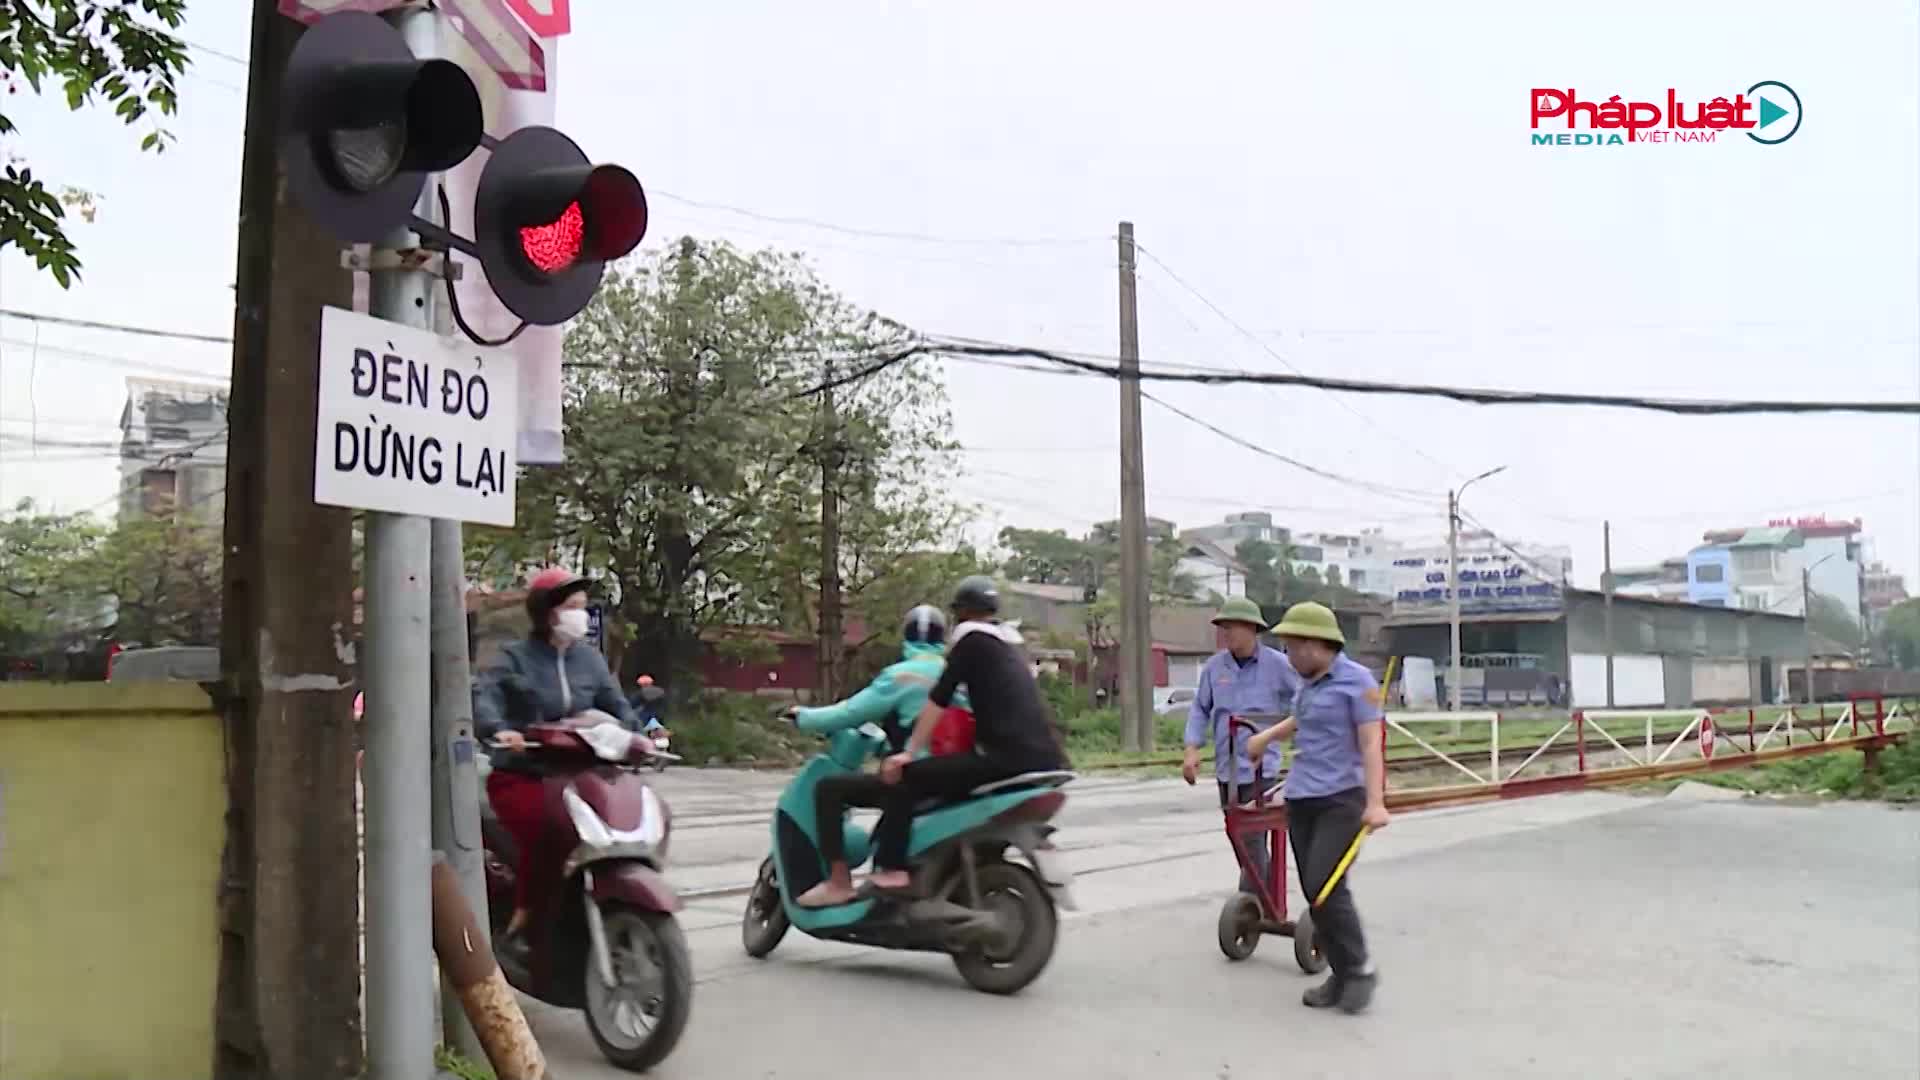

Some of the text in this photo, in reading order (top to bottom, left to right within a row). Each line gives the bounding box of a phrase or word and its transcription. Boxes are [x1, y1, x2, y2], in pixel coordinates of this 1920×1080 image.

[350, 340, 489, 421] ĐÈN ĐỎ
[334, 413, 506, 497] DỪNG LẠI
